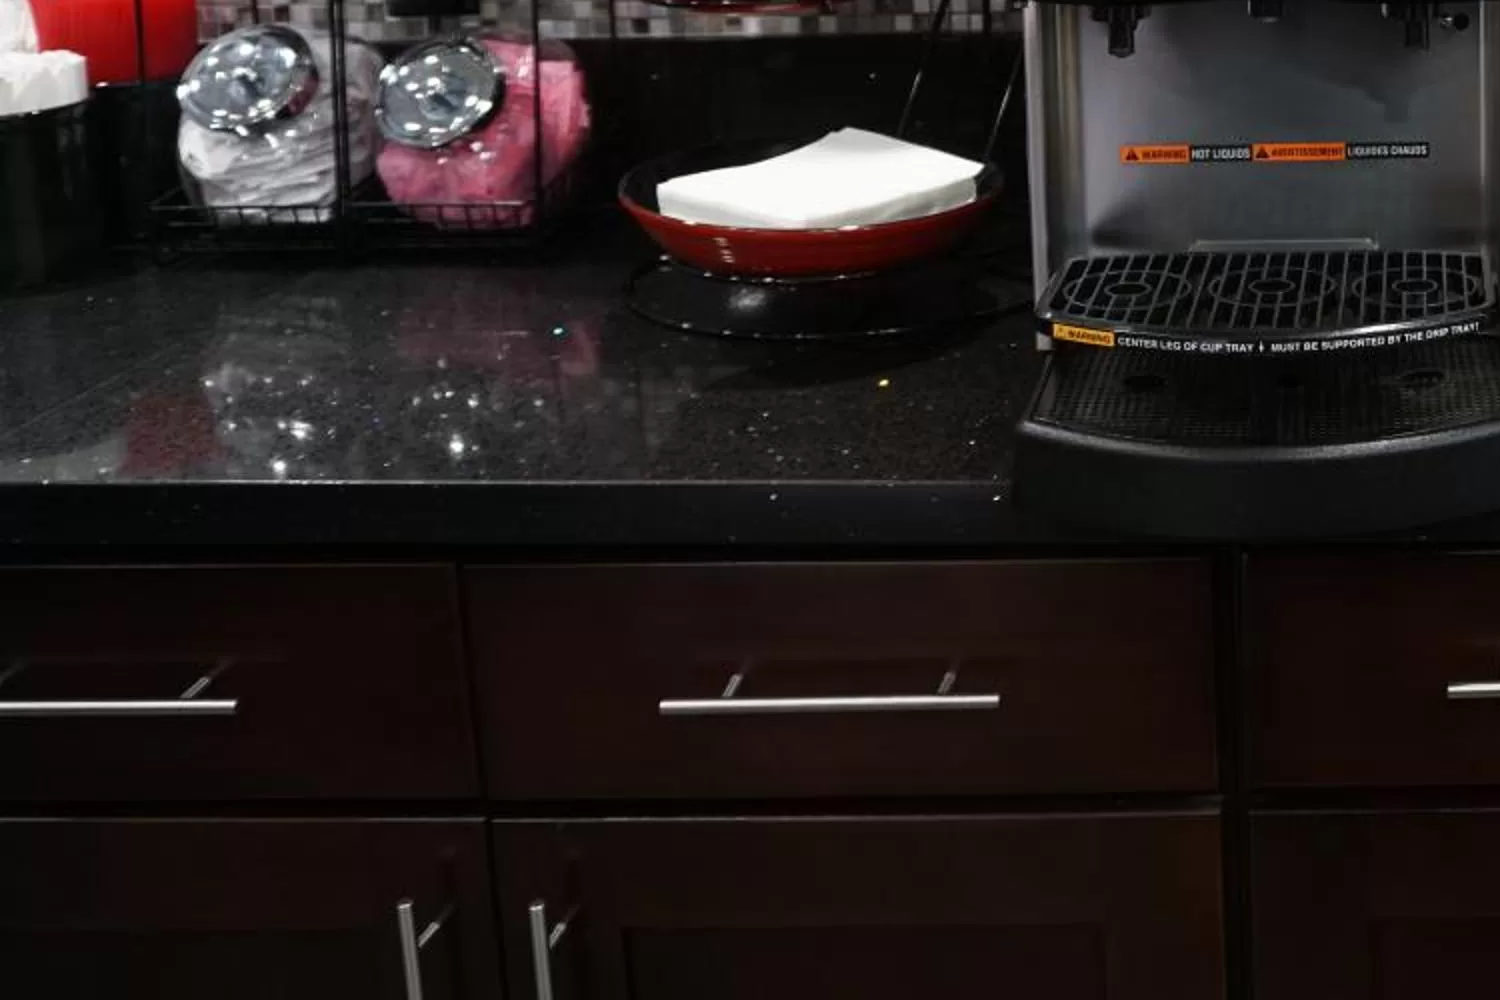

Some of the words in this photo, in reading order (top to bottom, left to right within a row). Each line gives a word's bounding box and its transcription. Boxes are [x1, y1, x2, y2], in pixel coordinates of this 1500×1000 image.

[1191, 147, 1210, 160] HOT
[1213, 146, 1250, 160] LIQUIDS
[1117, 336, 1158, 350] CENTER
[1159, 339, 1182, 351] LEG
[1183, 341, 1199, 352] OF
[1200, 341, 1224, 353] CUP
[1226, 342, 1254, 353] TRAY
[1271, 341, 1301, 352] MUST
[1303, 340, 1319, 351] BE
[1320, 336, 1385, 350] SUPPORTED
[1387, 334, 1401, 345] BY
[1404, 331, 1423, 343] THE
